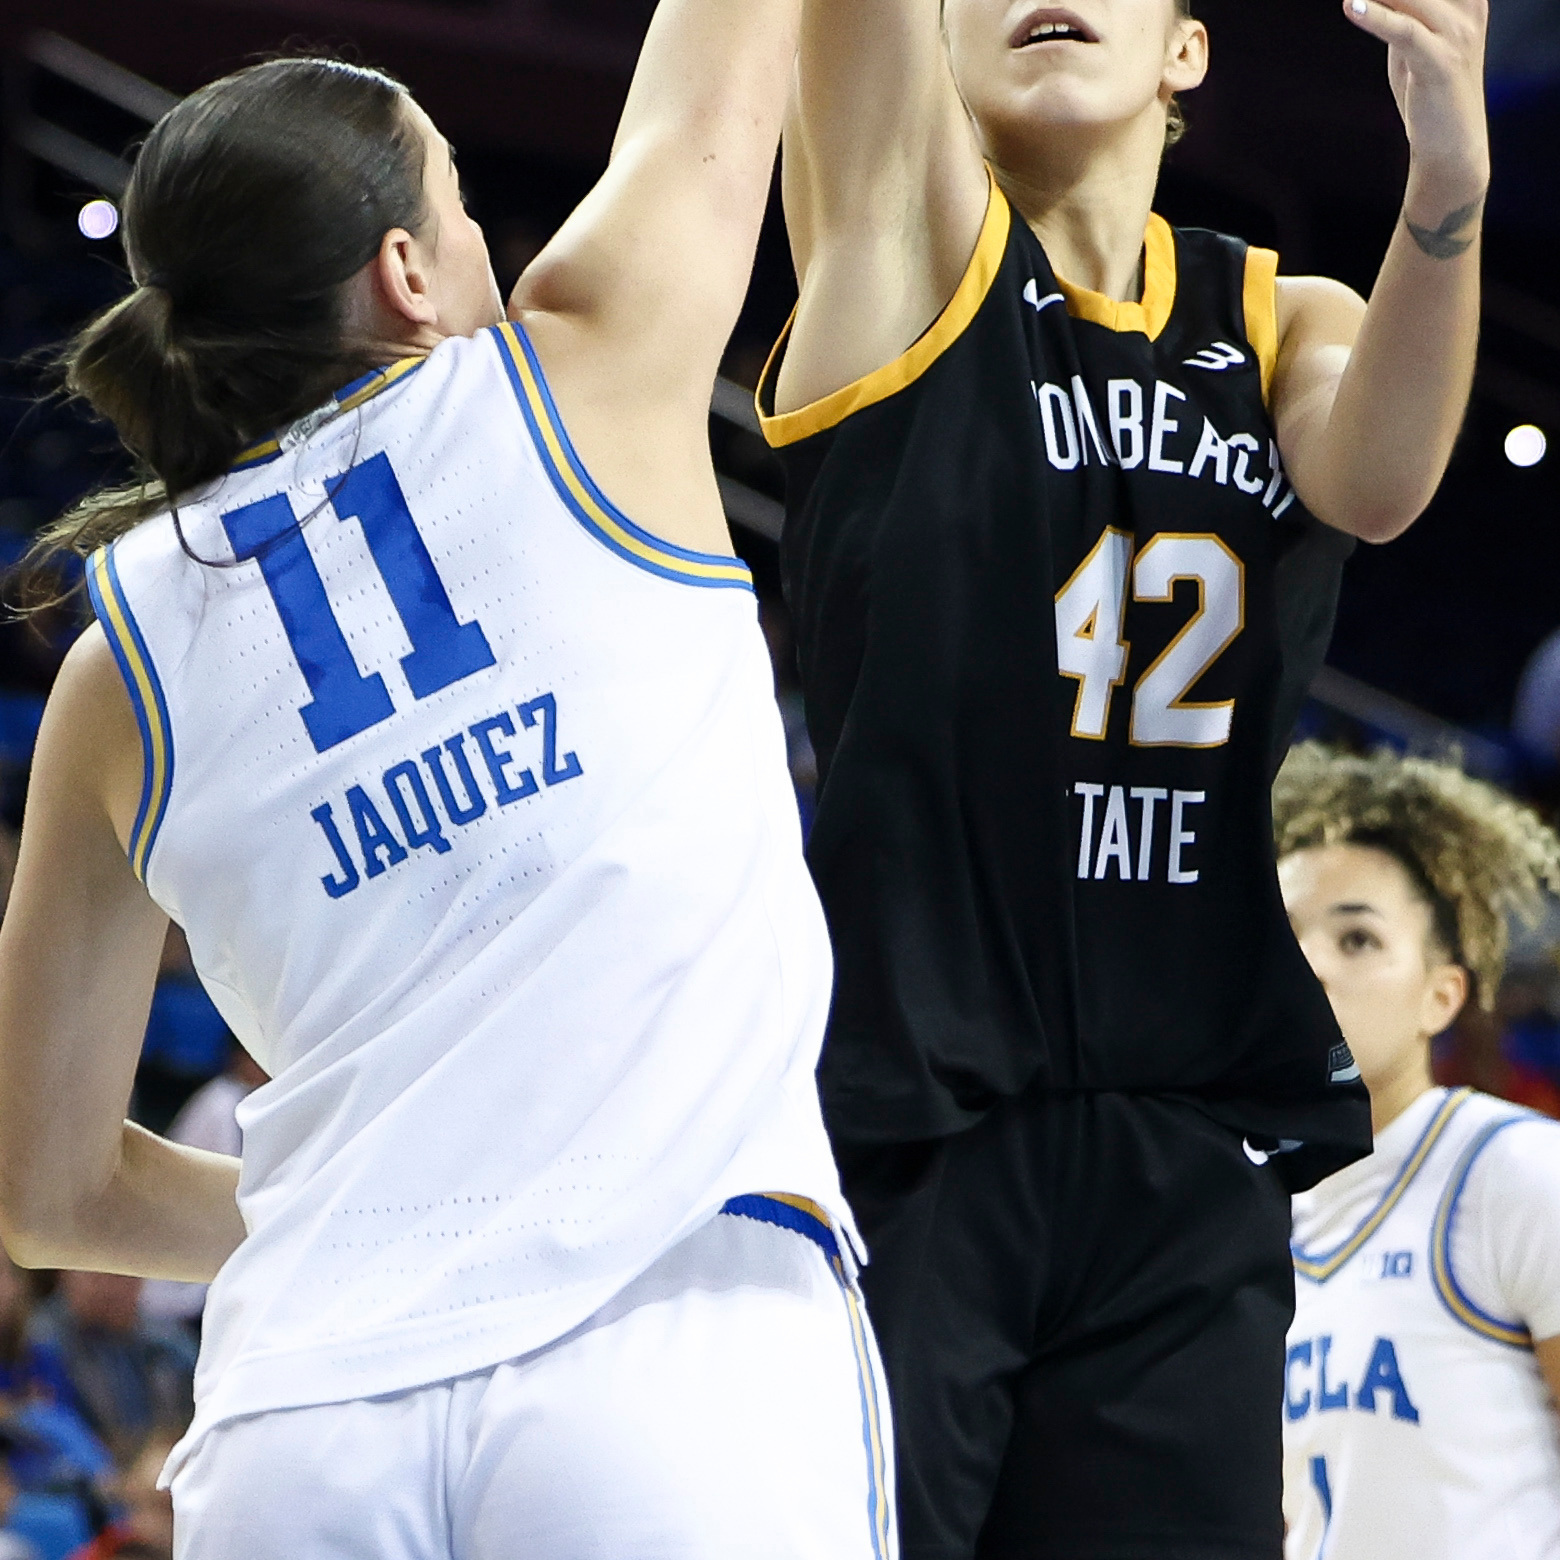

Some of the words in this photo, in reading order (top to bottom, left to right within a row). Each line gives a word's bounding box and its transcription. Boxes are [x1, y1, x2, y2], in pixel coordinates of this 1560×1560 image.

[220, 450, 497, 754] 11
[1054, 524, 1245, 749] 42
[310, 692, 584, 899] JAQUEZ
[1065, 781, 1206, 883] TATE
[1285, 1333, 1421, 1426] CLA
